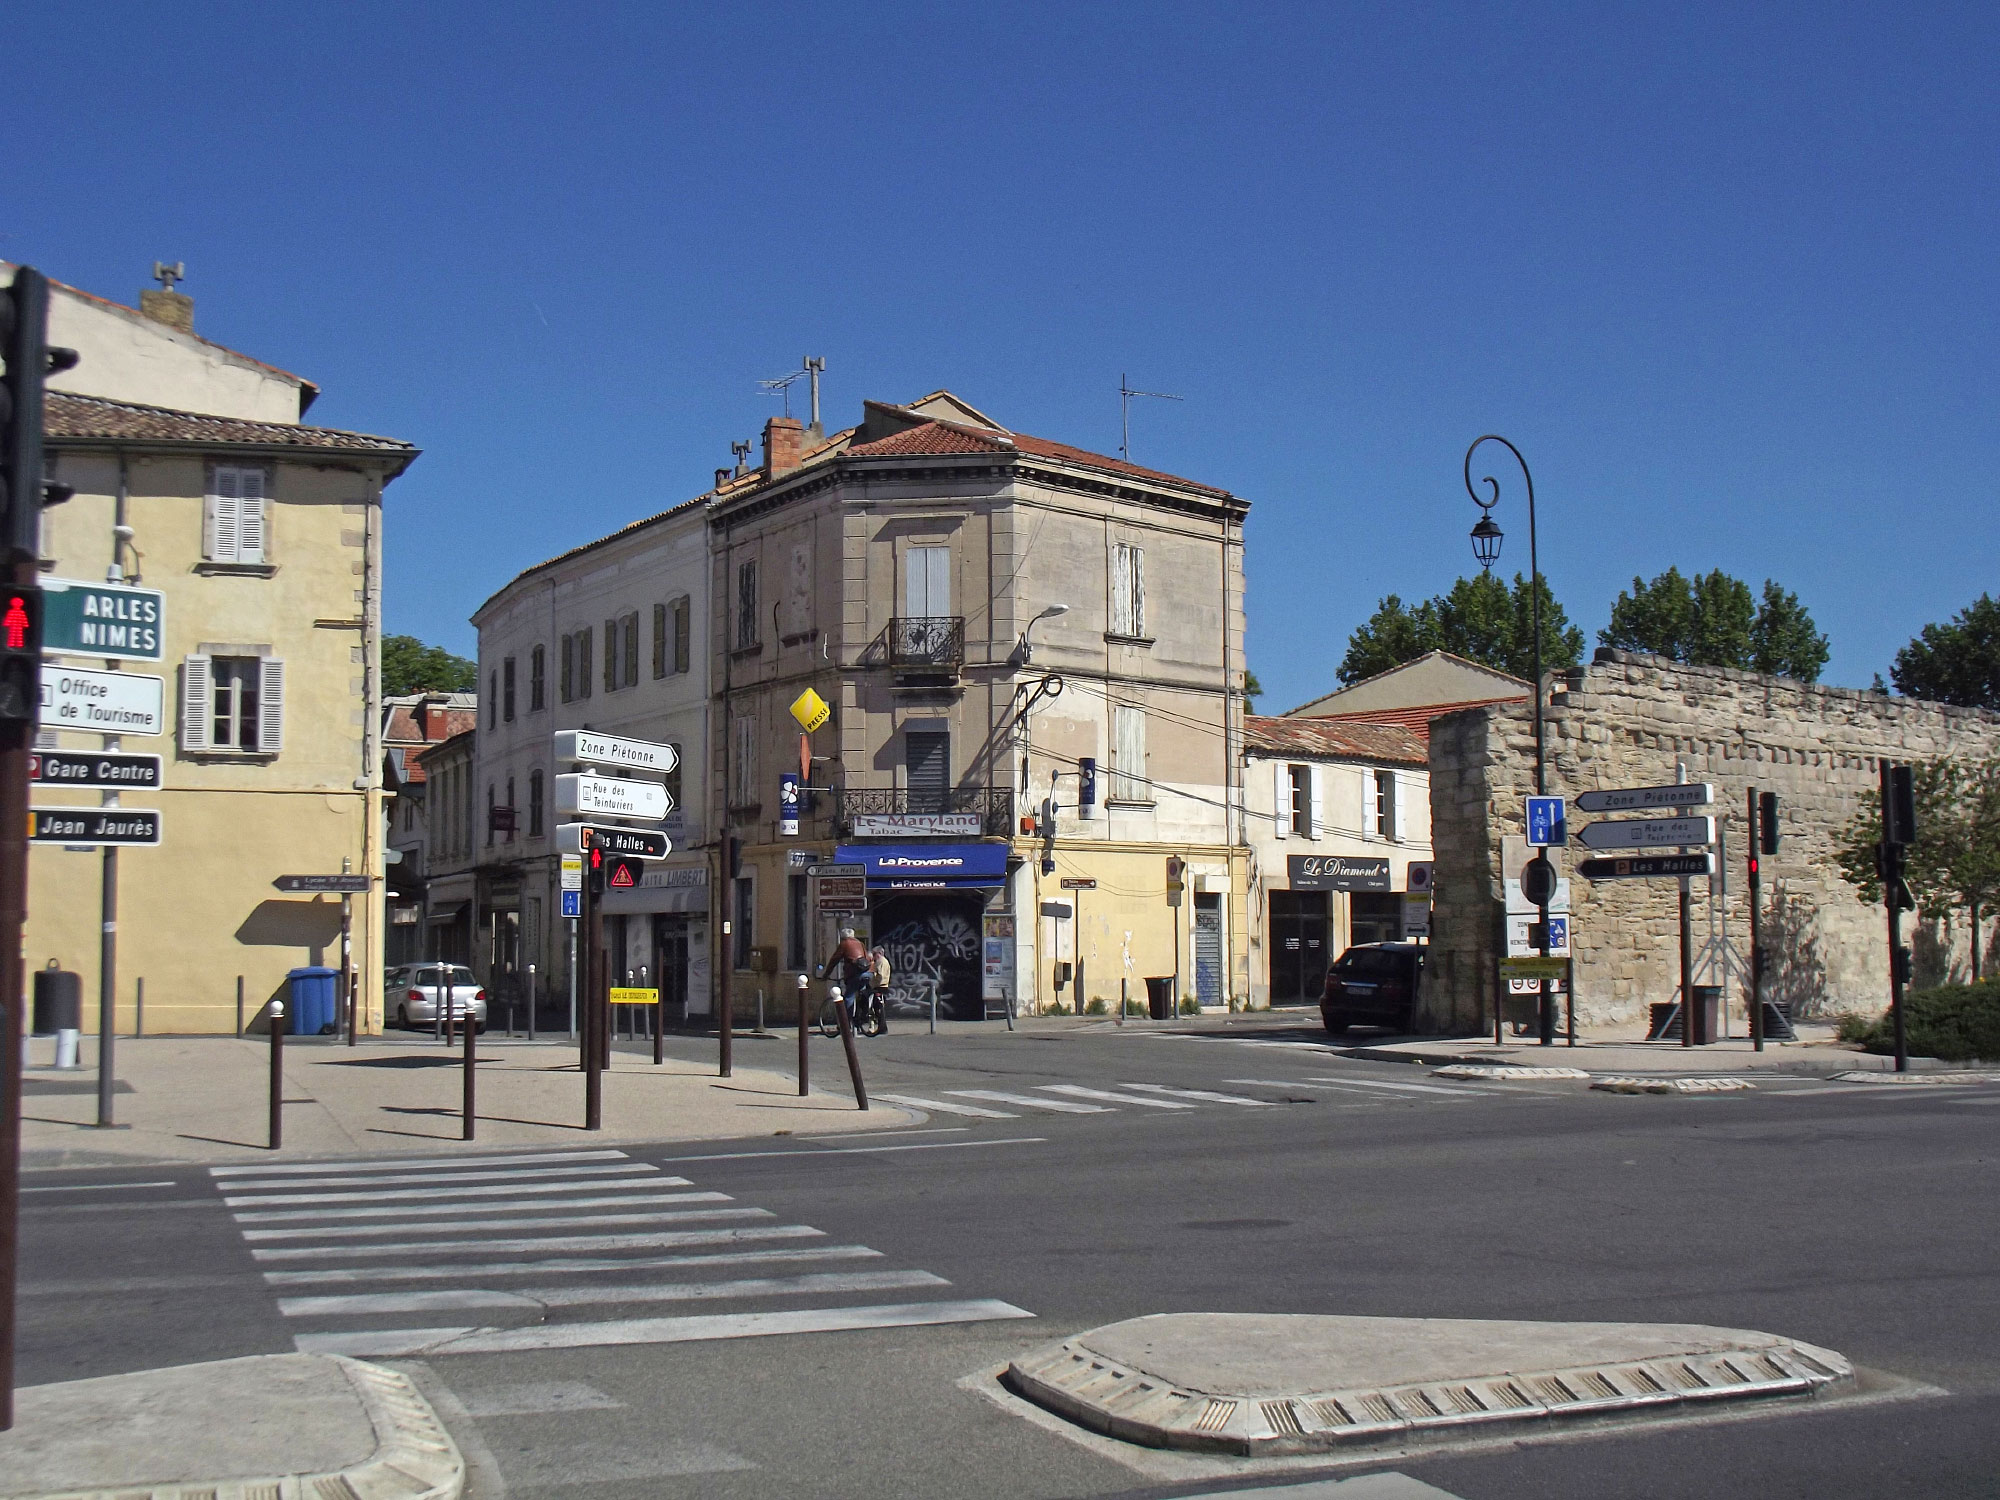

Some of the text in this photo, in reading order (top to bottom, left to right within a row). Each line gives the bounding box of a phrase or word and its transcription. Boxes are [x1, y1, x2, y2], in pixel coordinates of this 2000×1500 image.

[83, 594, 157, 623] ARLES
[81, 622, 156, 650] NIMES
[59, 677, 108, 697] Office
[59, 702, 153, 725] de Tourisme
[807, 708, 828, 729] PRESSE
[581, 739, 654, 762] Zone Piétonne
[46, 759, 89, 778] Gare
[97, 761, 155, 780] Centre
[593, 782, 625, 796] Rue des
[594, 796, 634, 811] Teinturiers
[1605, 791, 1701, 806] Zone Piétonne
[41, 816, 153, 836] Jean Jaurès
[856, 813, 980, 828] Le Maryland
[1644, 823, 1688, 832] Rue des
[616, 835, 645, 851] Halles
[879, 857, 963, 866] La Provence
[1302, 857, 1380, 876] Le Diamond
[1633, 862, 1653, 872] Les
[1662, 860, 1704, 871] Halles
[667, 869, 704, 886] LIMBERT
[891, 880, 946, 888] La Provence
